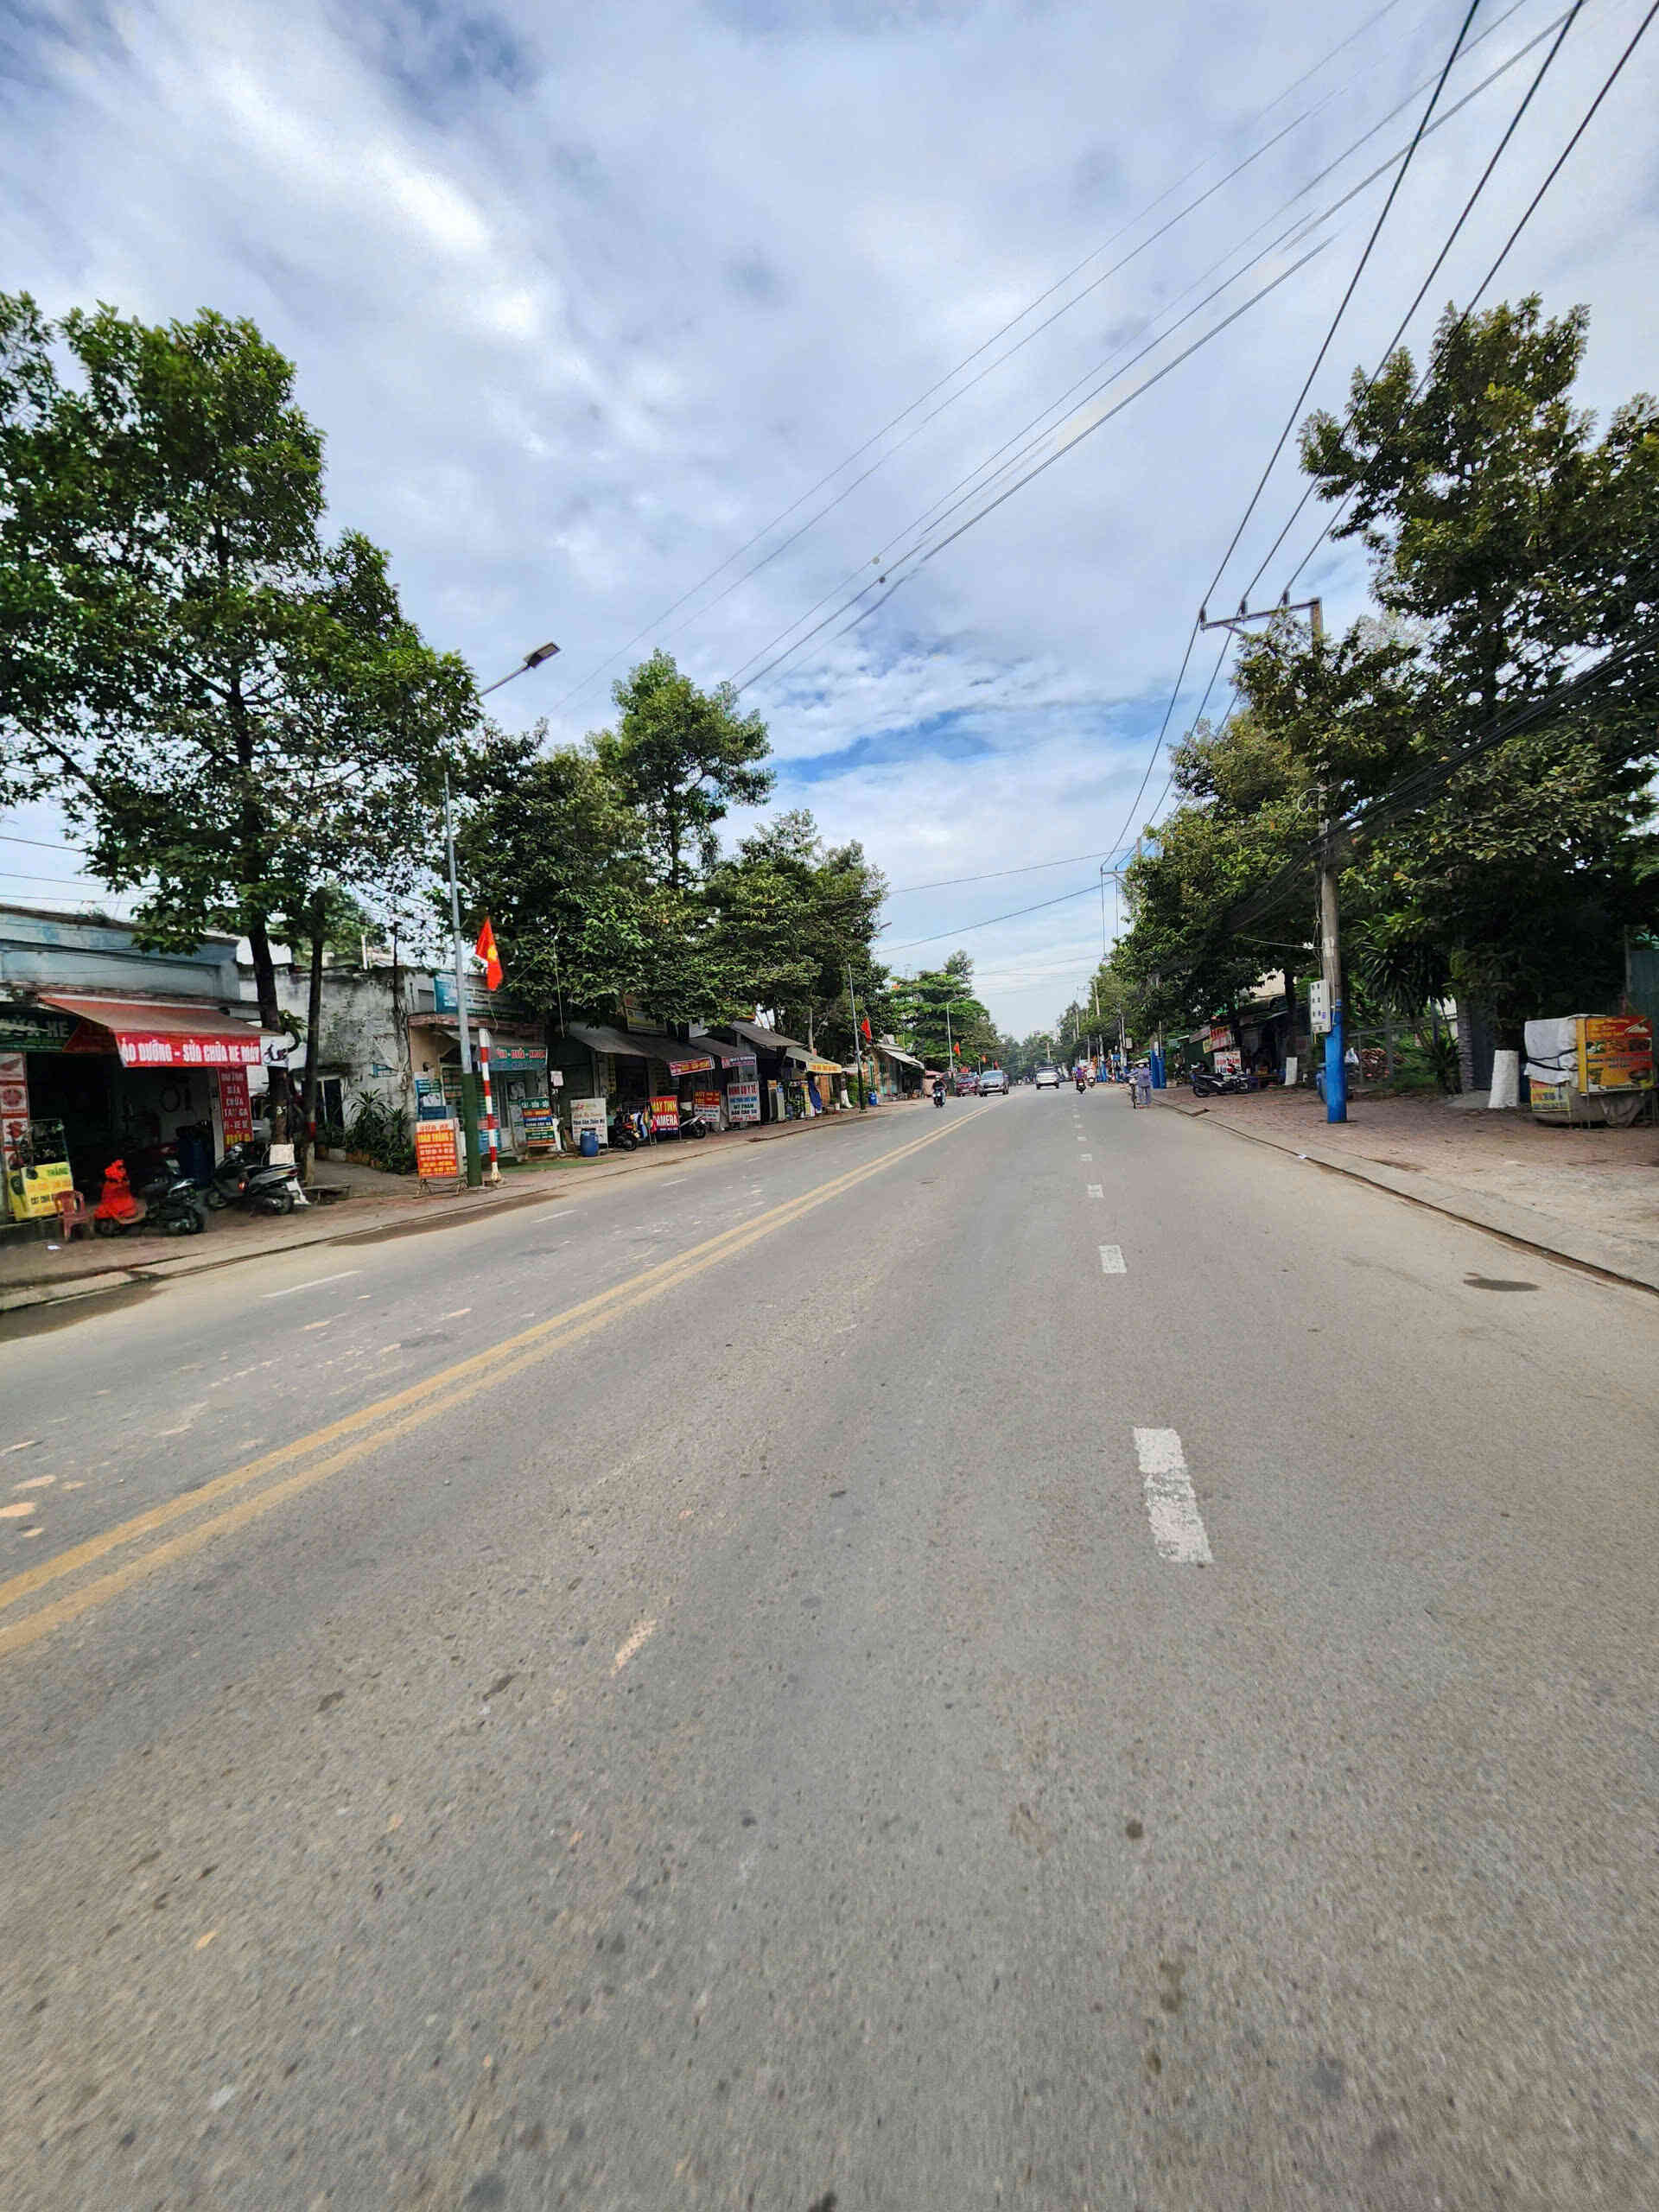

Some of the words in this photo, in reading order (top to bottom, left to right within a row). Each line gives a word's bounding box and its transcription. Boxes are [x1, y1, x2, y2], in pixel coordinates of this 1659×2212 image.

[137, 1039, 172, 1062] DƯỠNG
[182, 1039, 202, 1062] SỬA
[203, 1041, 228, 1062] CHỮA
[228, 1046, 240, 1062] XE
